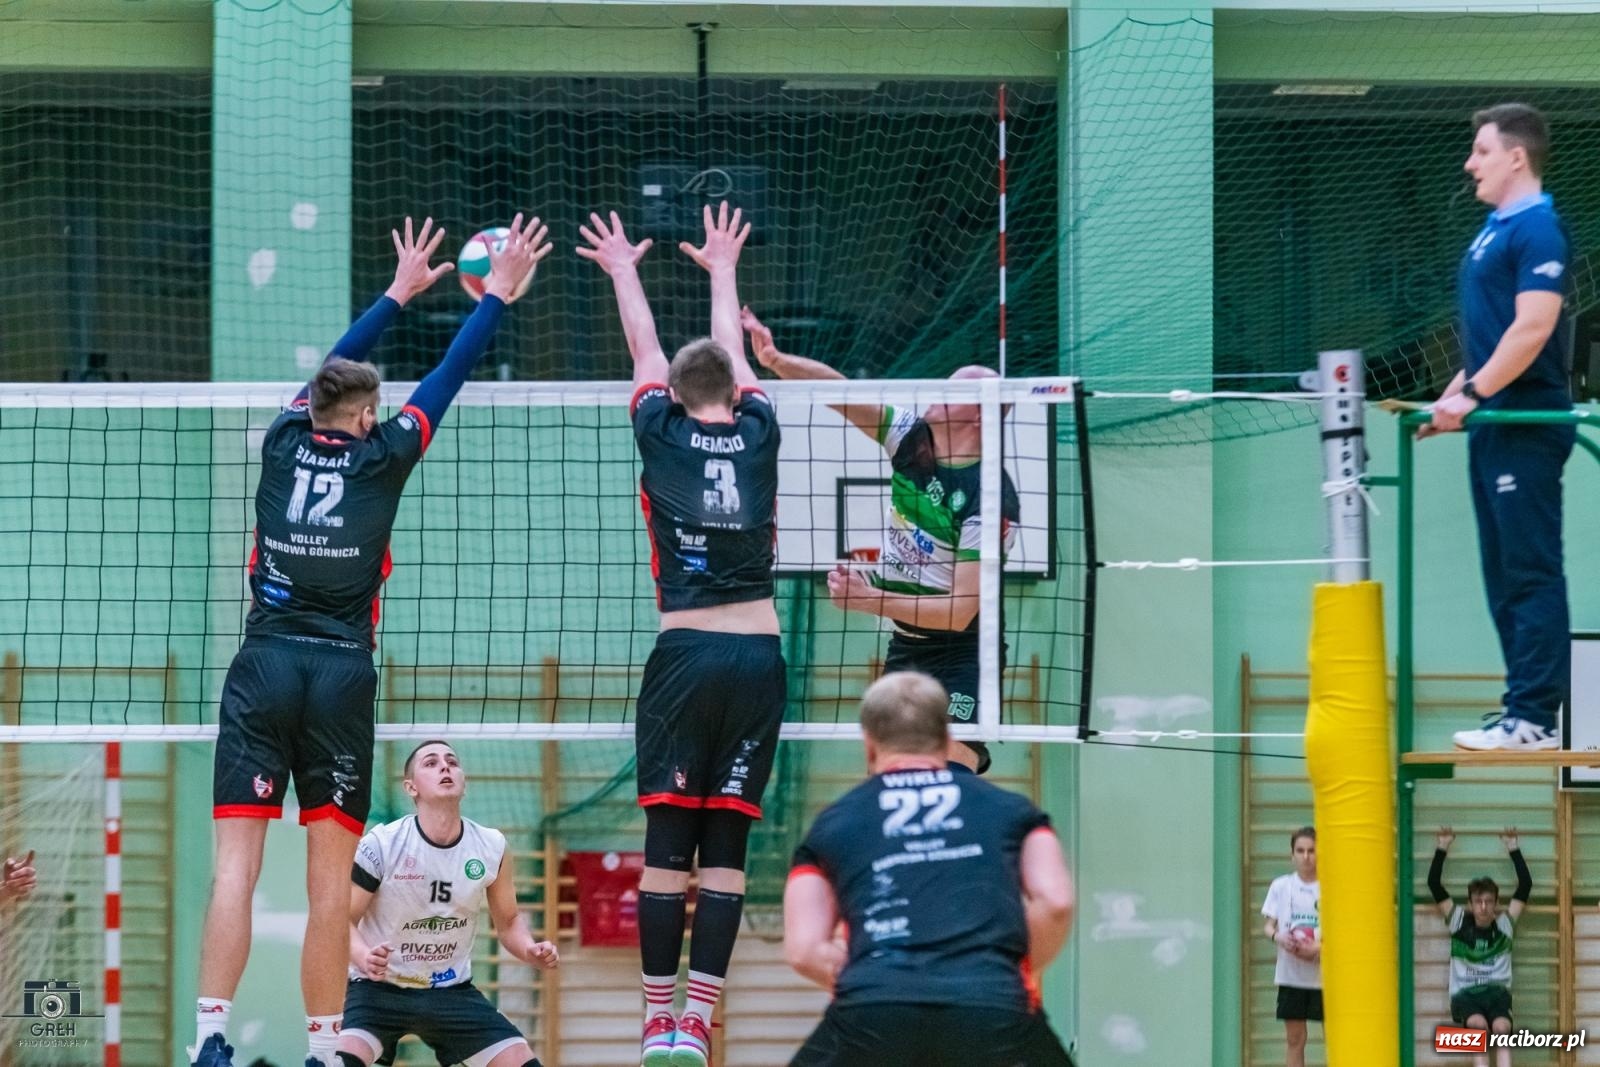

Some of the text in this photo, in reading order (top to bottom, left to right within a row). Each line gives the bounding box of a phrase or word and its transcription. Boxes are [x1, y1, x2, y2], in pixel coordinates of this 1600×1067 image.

[1031, 384, 1067, 395] netex
[286, 466, 345, 528] 12
[703, 458, 741, 514] 3
[264, 536, 360, 558] DĄBROWA GÓRNICZA
[290, 532, 329, 546] VOLLEY
[947, 692, 975, 720] 19
[878, 784, 964, 838] 22
[429, 880, 453, 903] 15
[401, 941, 458, 955] PIVEXIN
[402, 951, 454, 962] TECHNOLOGY
